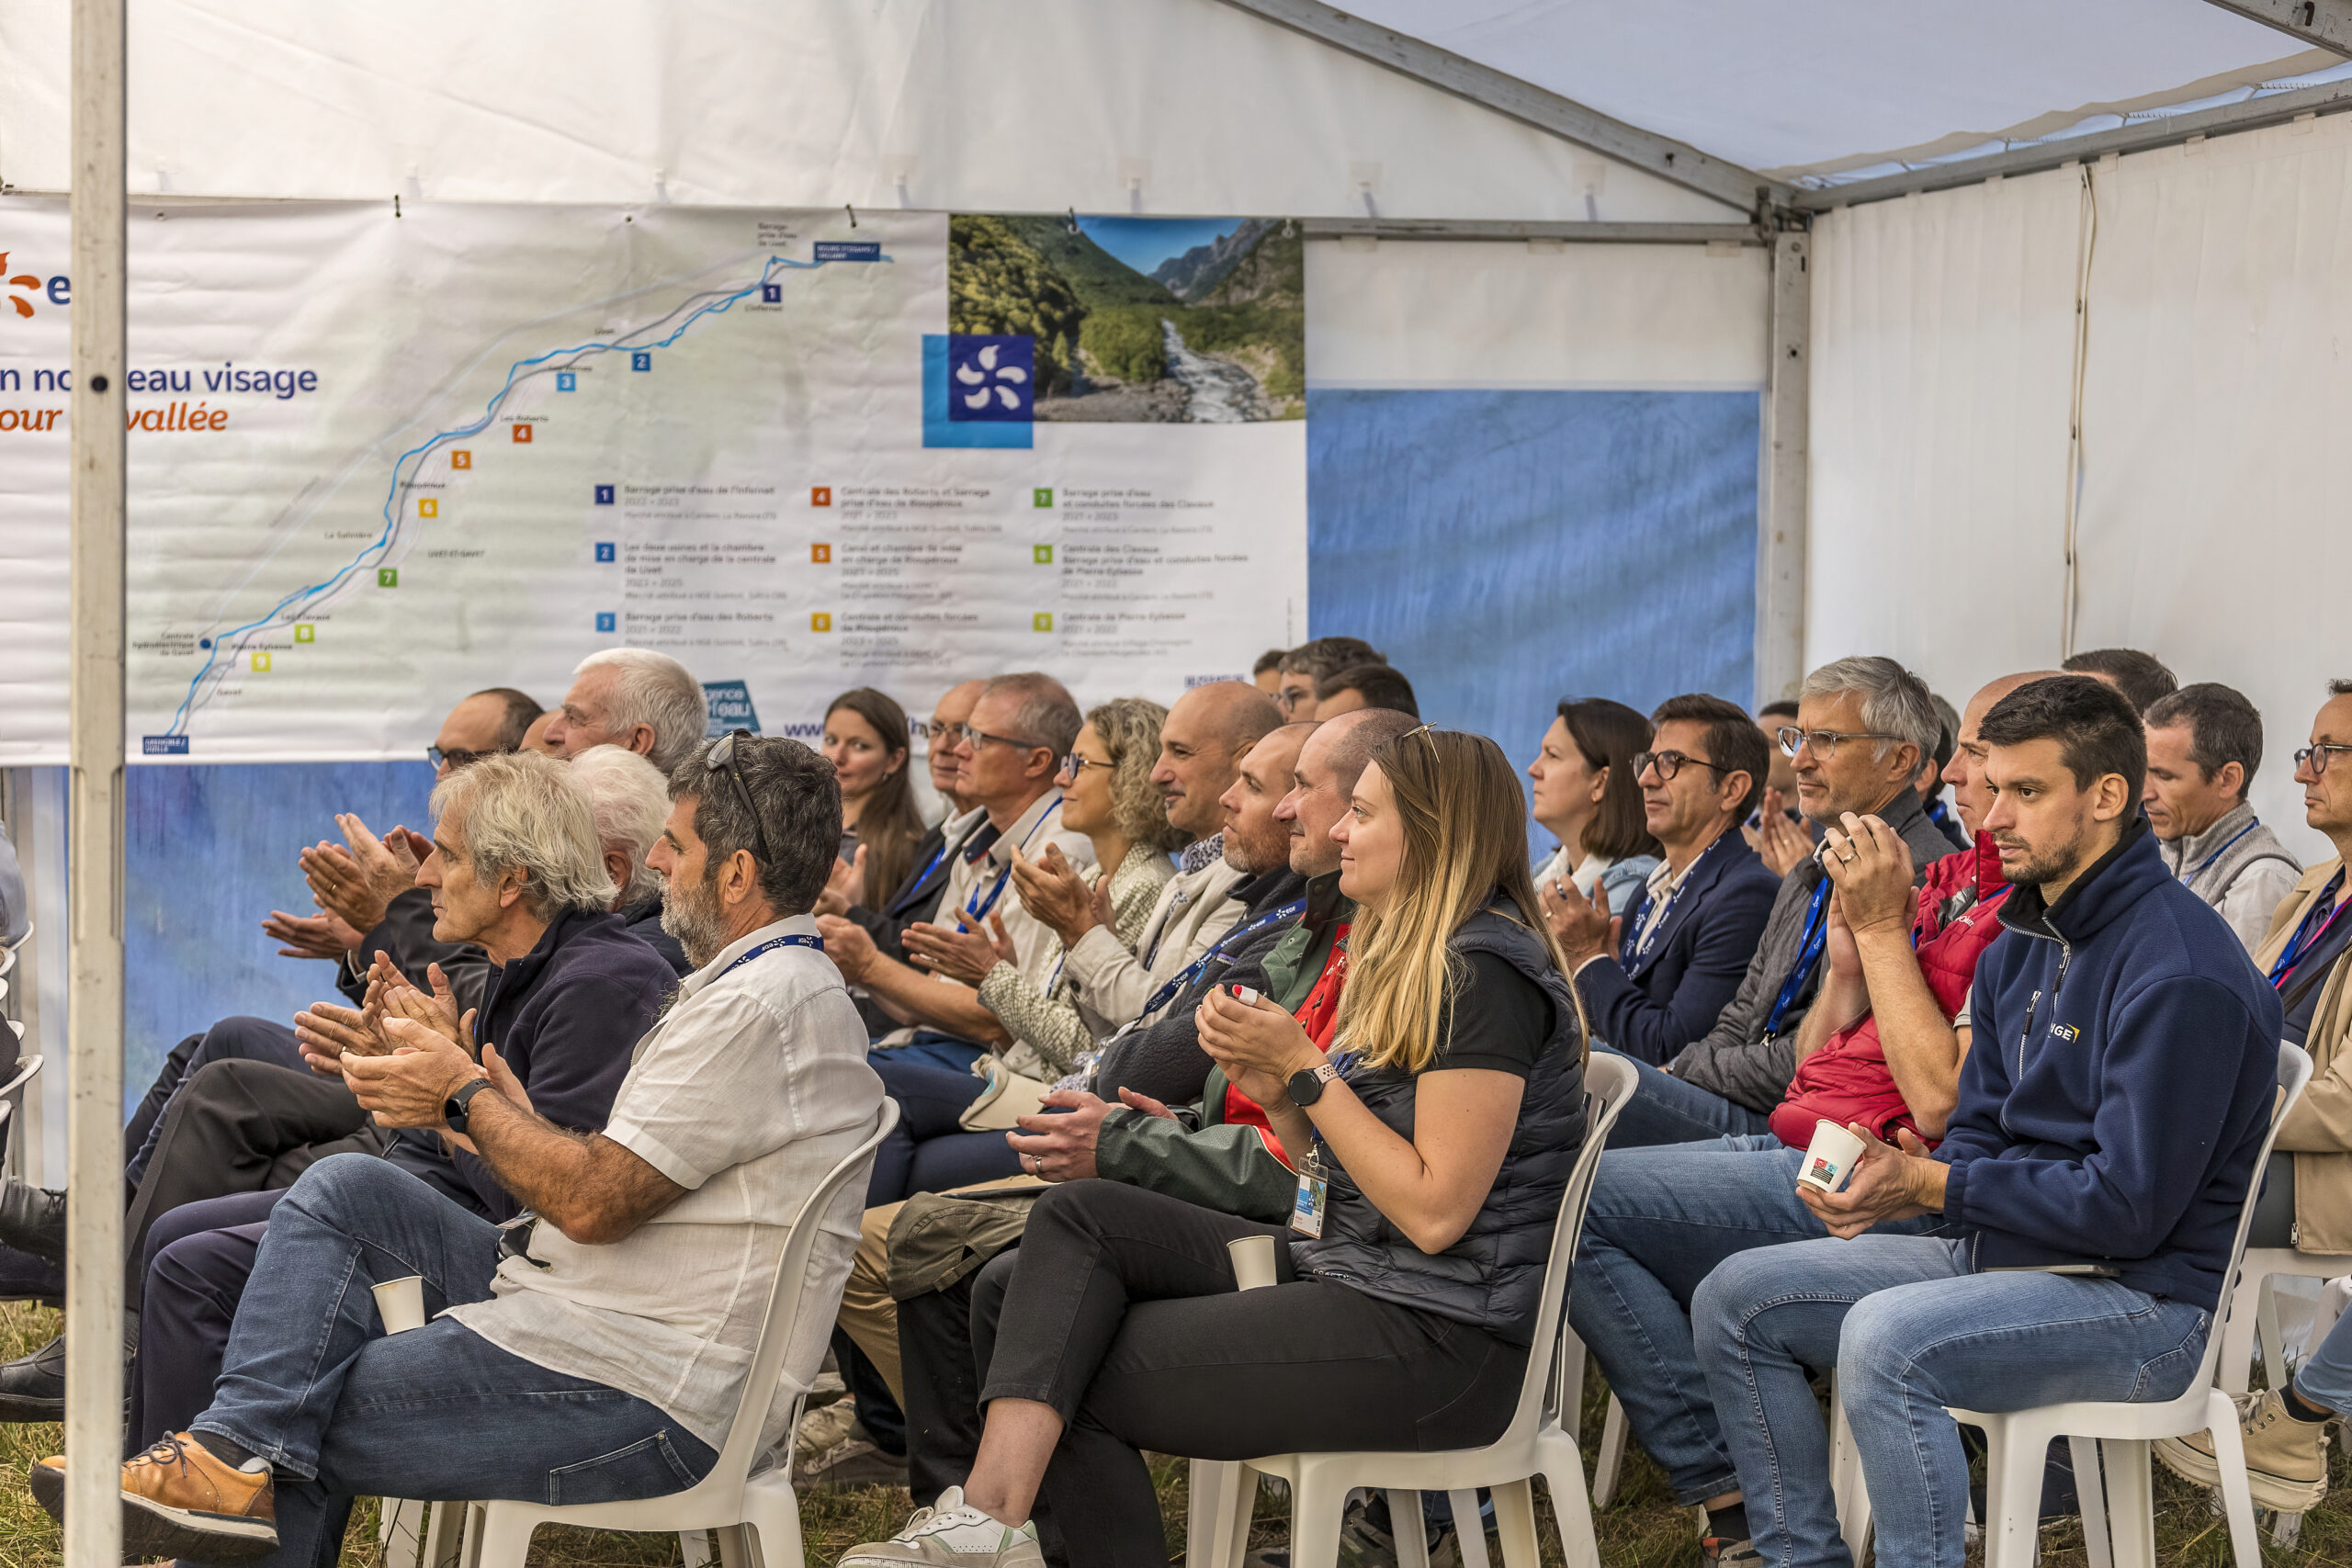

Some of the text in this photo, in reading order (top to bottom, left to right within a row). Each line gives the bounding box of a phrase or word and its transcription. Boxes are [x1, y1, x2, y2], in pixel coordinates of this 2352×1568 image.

[768, 288, 776, 299] 1
[637, 355, 648, 369] 2
[0, 369, 21, 392] n
[203, 361, 319, 400] visage
[561, 375, 571, 389] 3
[0, 401, 229, 432] our vallée
[516, 427, 526, 439] 4
[458, 454, 466, 467] 5
[601, 489, 609, 501] 1
[817, 491, 825, 502] 4
[1039, 492, 1047, 503] 7
[424, 502, 434, 514] 6
[601, 547, 610, 559] 2
[817, 548, 825, 558] 5
[384, 572, 392, 584] 7
[602, 616, 610, 628] 3
[817, 616, 825, 627] 6
[1038, 617, 1046, 628] 9
[256, 656, 266, 669] 9
